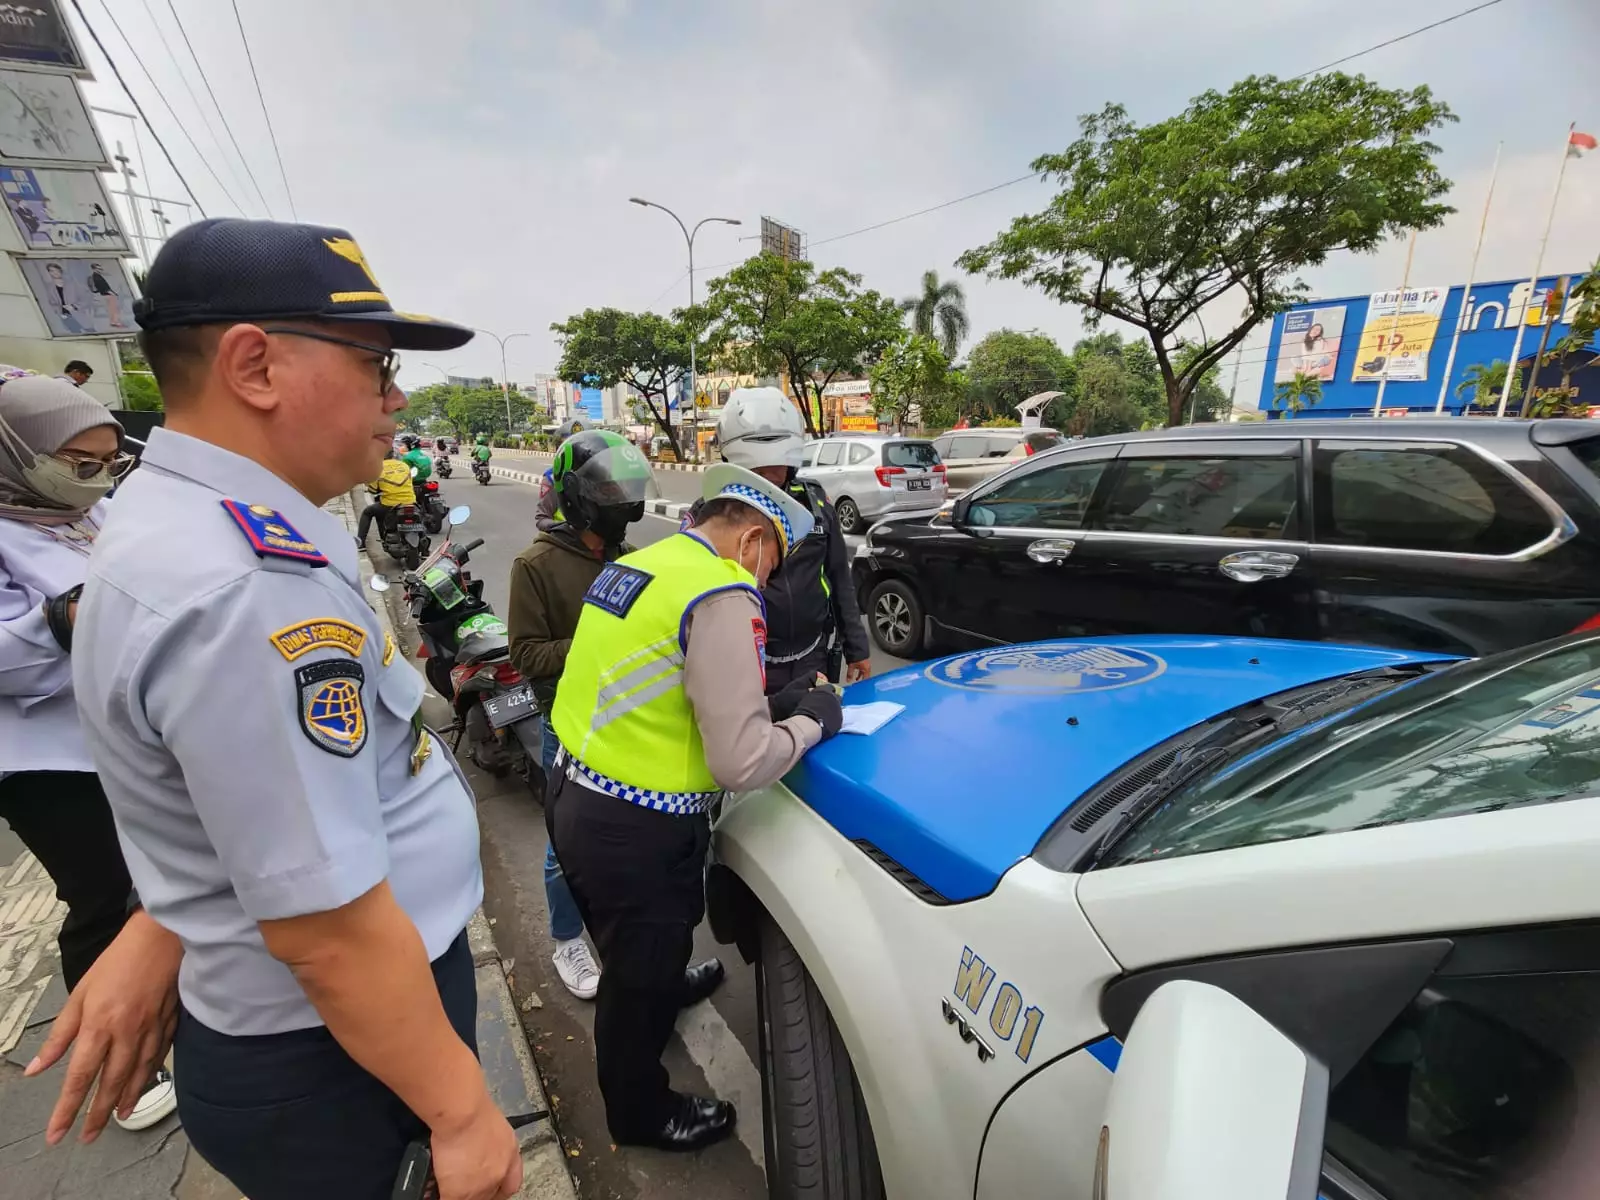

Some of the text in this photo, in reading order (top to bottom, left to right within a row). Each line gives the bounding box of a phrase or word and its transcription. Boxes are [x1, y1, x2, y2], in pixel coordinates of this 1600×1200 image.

[280, 628, 313, 652] DINAS
[489, 703, 499, 714] E
[507, 690, 533, 707] 4252
